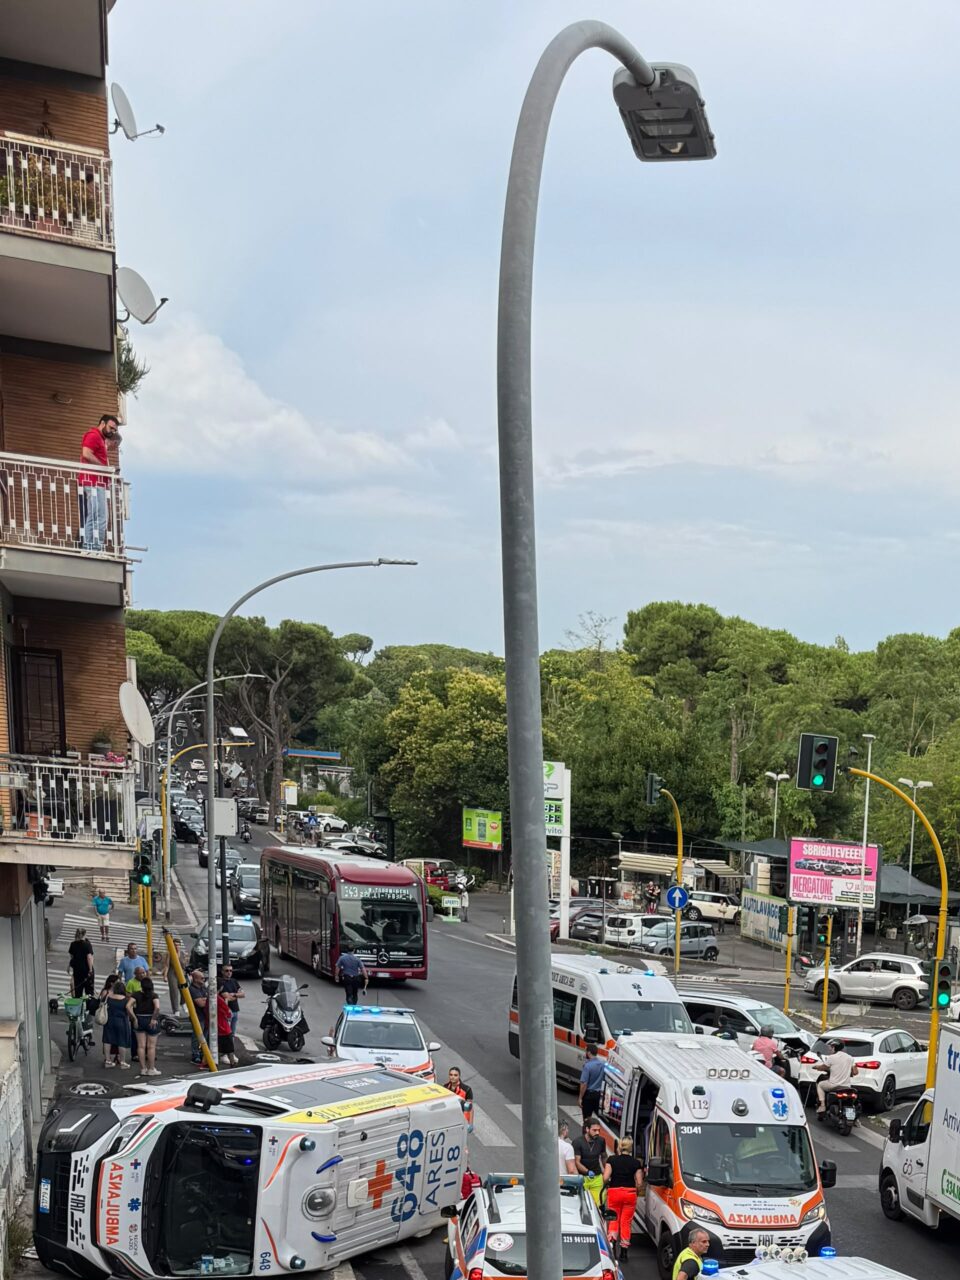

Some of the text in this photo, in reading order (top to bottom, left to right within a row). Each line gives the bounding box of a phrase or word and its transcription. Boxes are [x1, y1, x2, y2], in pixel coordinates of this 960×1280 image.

[744, 896, 779, 919] AUTOLAVAGG
[691, 1100, 709, 1110] 112
[391, 1129, 424, 1222] 648
[426, 1131, 446, 1206] ARES
[444, 1145, 461, 1188] 118
[71, 1193, 86, 1214] FIAT
[758, 1235, 775, 1247] FIAT
[260, 1251, 272, 1271] 648
